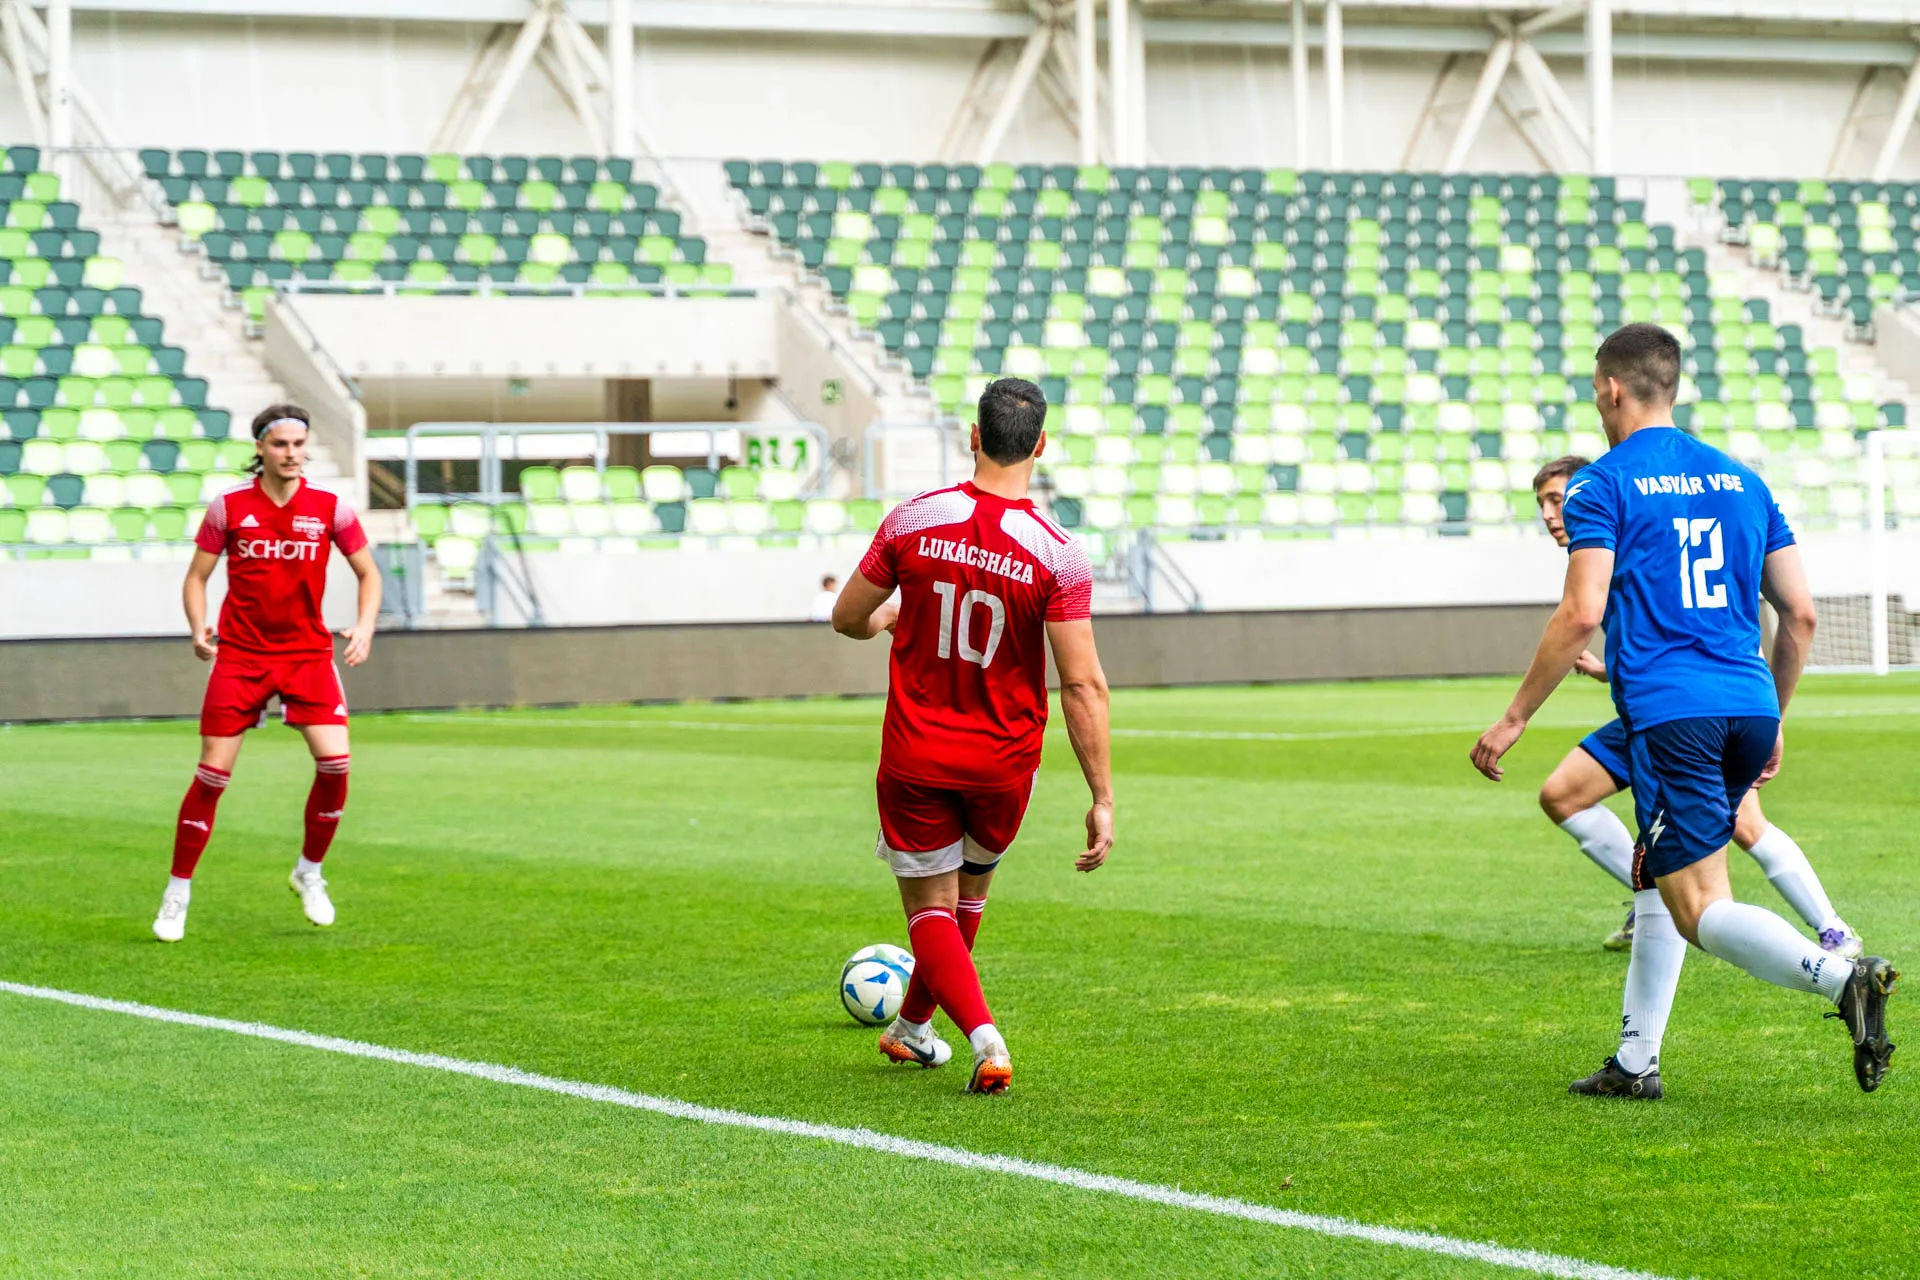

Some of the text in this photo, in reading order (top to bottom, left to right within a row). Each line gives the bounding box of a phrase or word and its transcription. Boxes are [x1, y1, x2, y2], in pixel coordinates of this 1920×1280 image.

[1706, 473, 1745, 493] VSE
[237, 539, 320, 561] SCHOTT
[918, 536, 1034, 585] LUKÁCSHÁZA
[1672, 517, 1728, 609] 12
[933, 580, 1006, 669] 10
